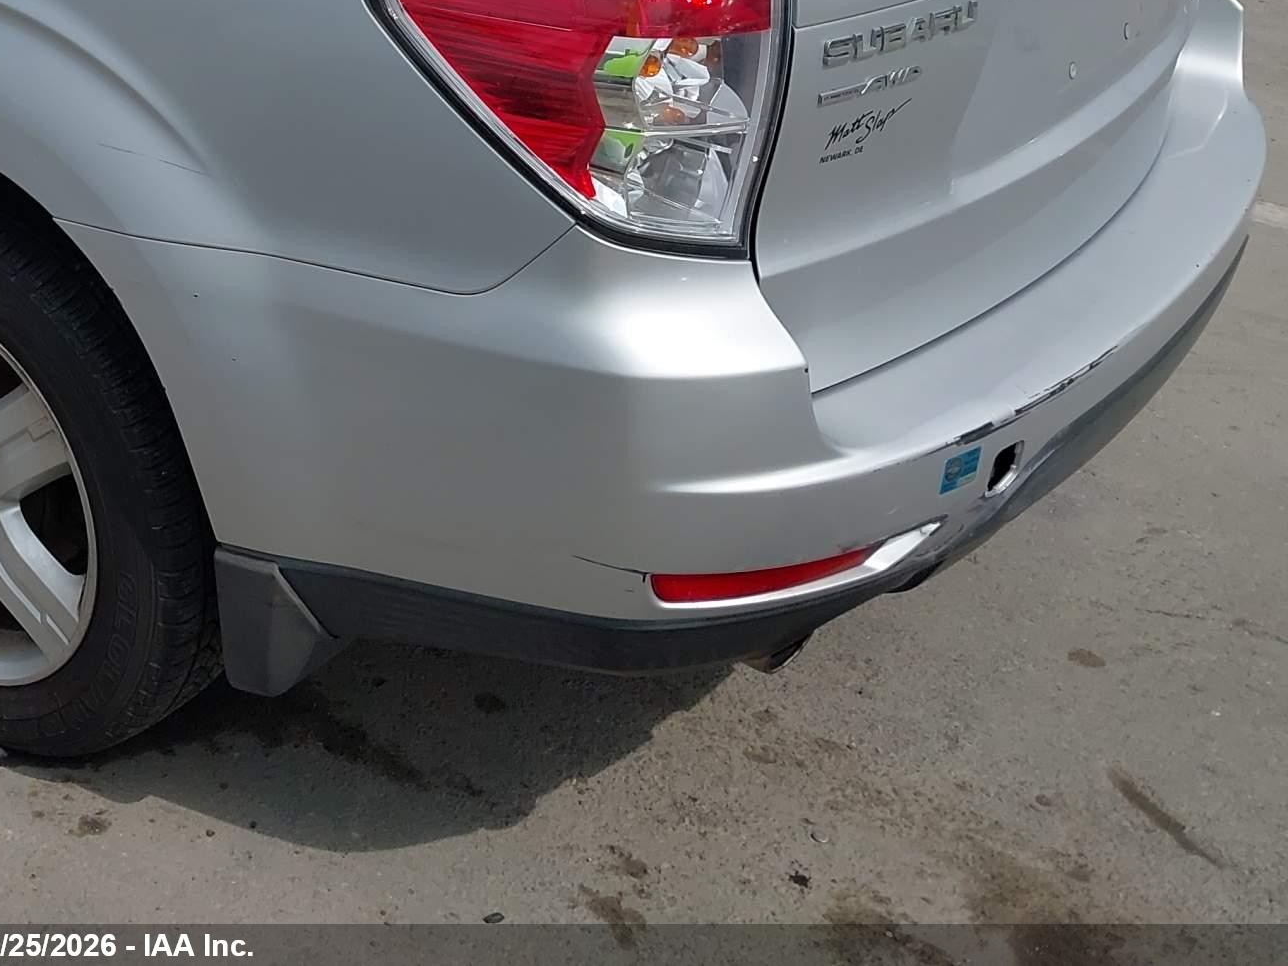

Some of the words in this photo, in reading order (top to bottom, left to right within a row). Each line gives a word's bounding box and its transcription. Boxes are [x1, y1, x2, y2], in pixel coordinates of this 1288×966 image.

[822, 0, 979, 67] SUBARU
[824, 110, 874, 151] Matt
[854, 146, 864, 154] DE
